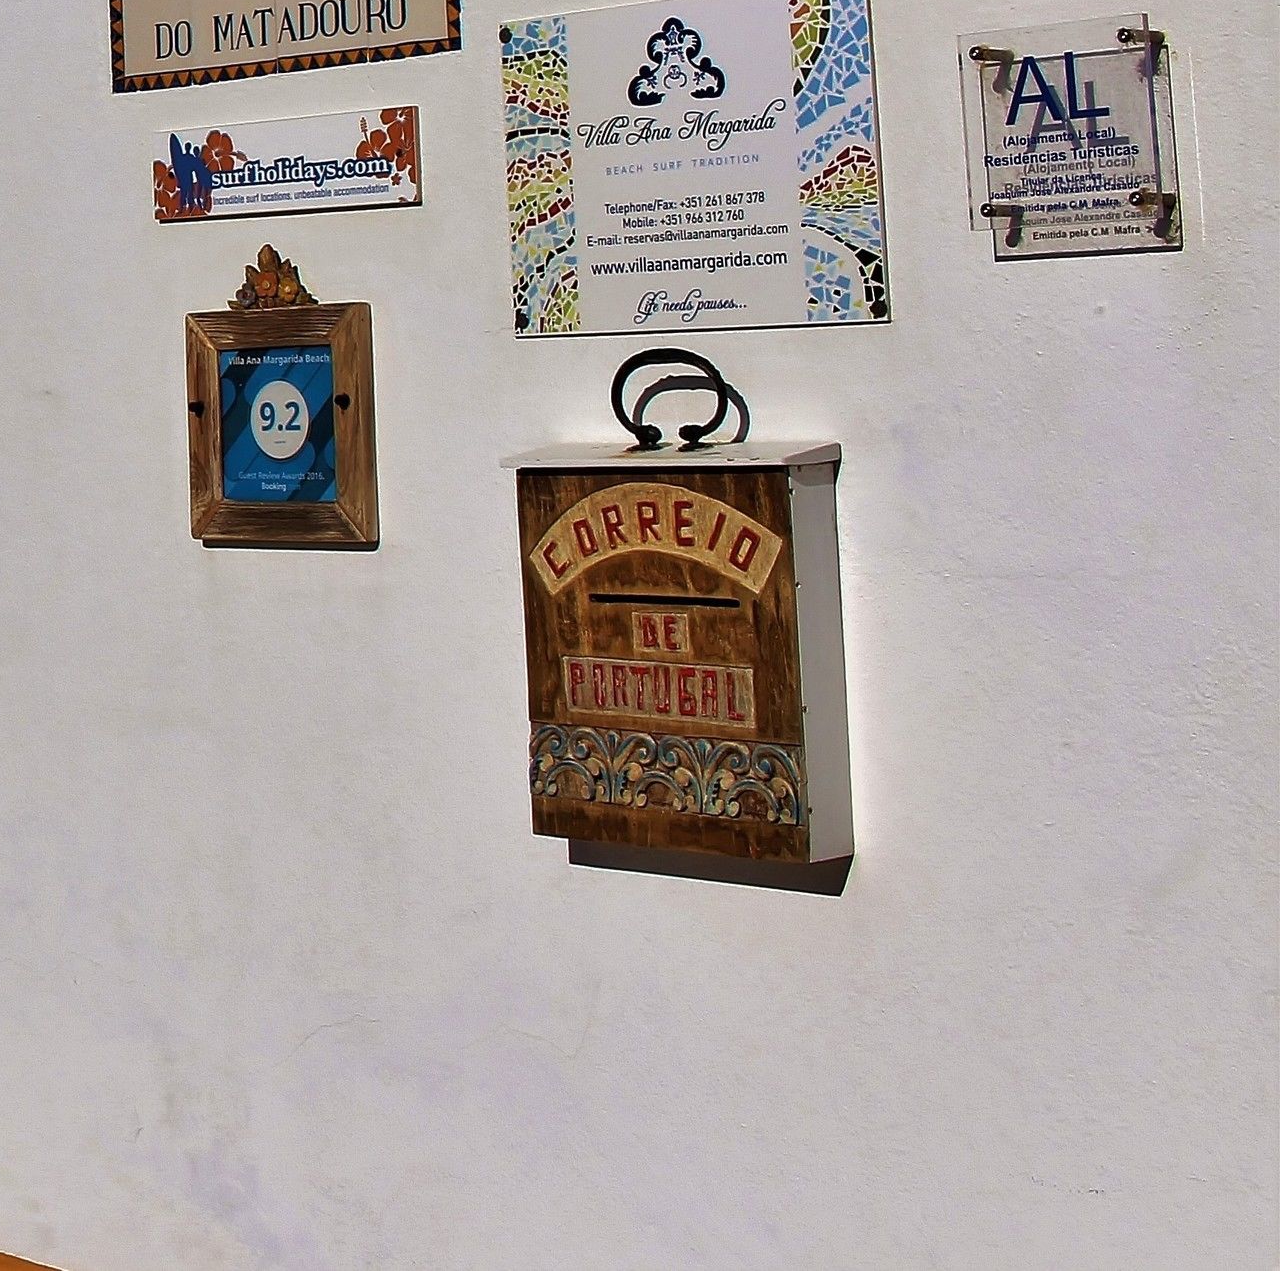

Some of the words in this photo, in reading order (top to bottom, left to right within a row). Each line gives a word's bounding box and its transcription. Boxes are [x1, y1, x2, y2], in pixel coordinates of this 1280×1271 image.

[154, 20, 192, 60] DO
[1005, 51, 1110, 126] AL
[577, 115, 630, 149] Villa
[625, 116, 672, 146] Ana
[678, 98, 786, 151] Margarida
[1002, 131, 1074, 149] (Alojamento
[1078, 126, 1116, 141] Local)
[211, 157, 390, 187] surfholidays.com
[606, 164, 643, 176] BEACH
[653, 160, 683, 172] SURF
[692, 154, 760, 168] TRADITION
[246, 193, 259, 204] surf
[334, 184, 389, 197] accommodation
[604, 199, 677, 215] Telephone/Fax:
[679, 196, 702, 209] +351
[705, 194, 723, 207] 261
[726, 193, 744, 205] 867
[746, 191, 765, 203] 378
[622, 215, 658, 229] Mobile:
[660, 213, 683, 226] +351
[685, 212, 703, 224] 966
[705, 210, 724, 222] 312
[726, 209, 744, 221] 760
[587, 234, 622, 247] E-mail:
[624, 224, 789, 245] reservas@villaanamargarida.com
[591, 251, 788, 275] www.villaanamargarida.com
[633, 290, 667, 325] Life
[662, 288, 702, 312] needs
[681, 298, 747, 323] pauses...
[228, 356, 244, 365] Villa
[246, 356, 260, 365] Ana
[263, 354, 303, 366] Margarida
[305, 353, 330, 363] Beach
[259, 401, 301, 432] 9.2
[542, 500, 761, 579] CORREIO
[641, 615, 680, 650] DE
[570, 662, 745, 721] PORTUGAL
